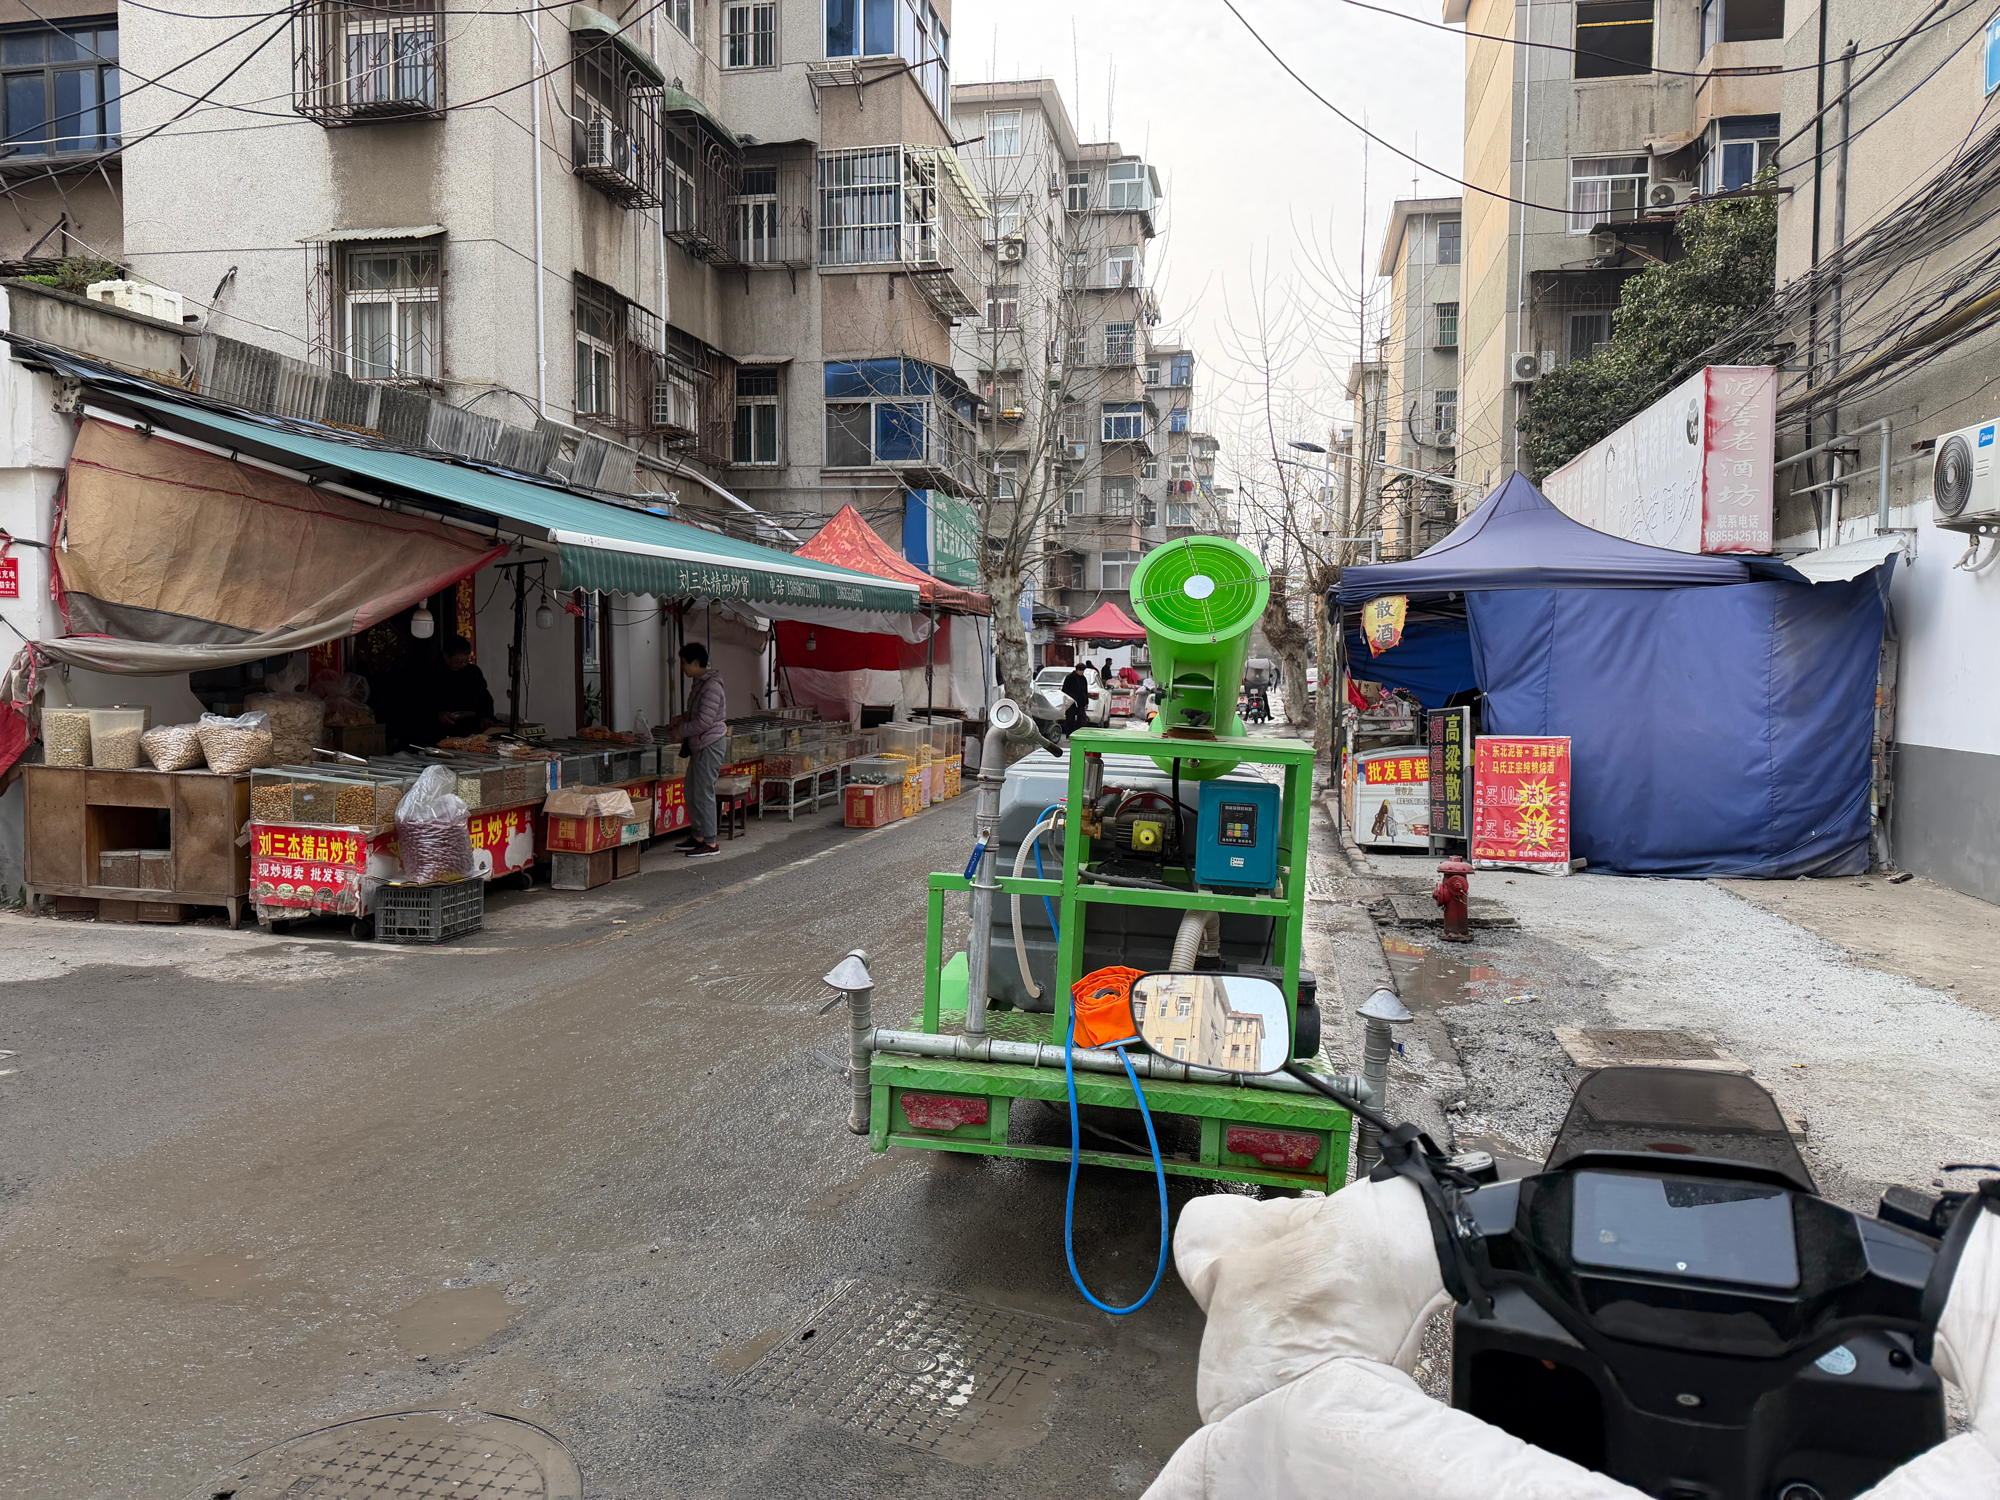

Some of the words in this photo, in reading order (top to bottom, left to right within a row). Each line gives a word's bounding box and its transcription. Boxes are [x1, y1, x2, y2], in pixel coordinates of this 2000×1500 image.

[1717, 377, 1762, 507] 泥窖老酒坊
[1716, 514, 1760, 529] 联系电话
[1705, 530, 1769, 543] 18855425138
[0, 570, 15, 579] 充电
[769, 577, 785, 596] 电话
[1374, 600, 1395, 642] 散酒
[1368, 758, 1429, 783] 批发雪糕
[1430, 715, 1445, 831] 烟酒超市
[1445, 714, 1461, 832] 高粱散酒
[665, 783, 686, 807] 刘三
[258, 831, 358, 865] 刘三杰精品炒货
[258, 863, 304, 880] 现炒现卖
